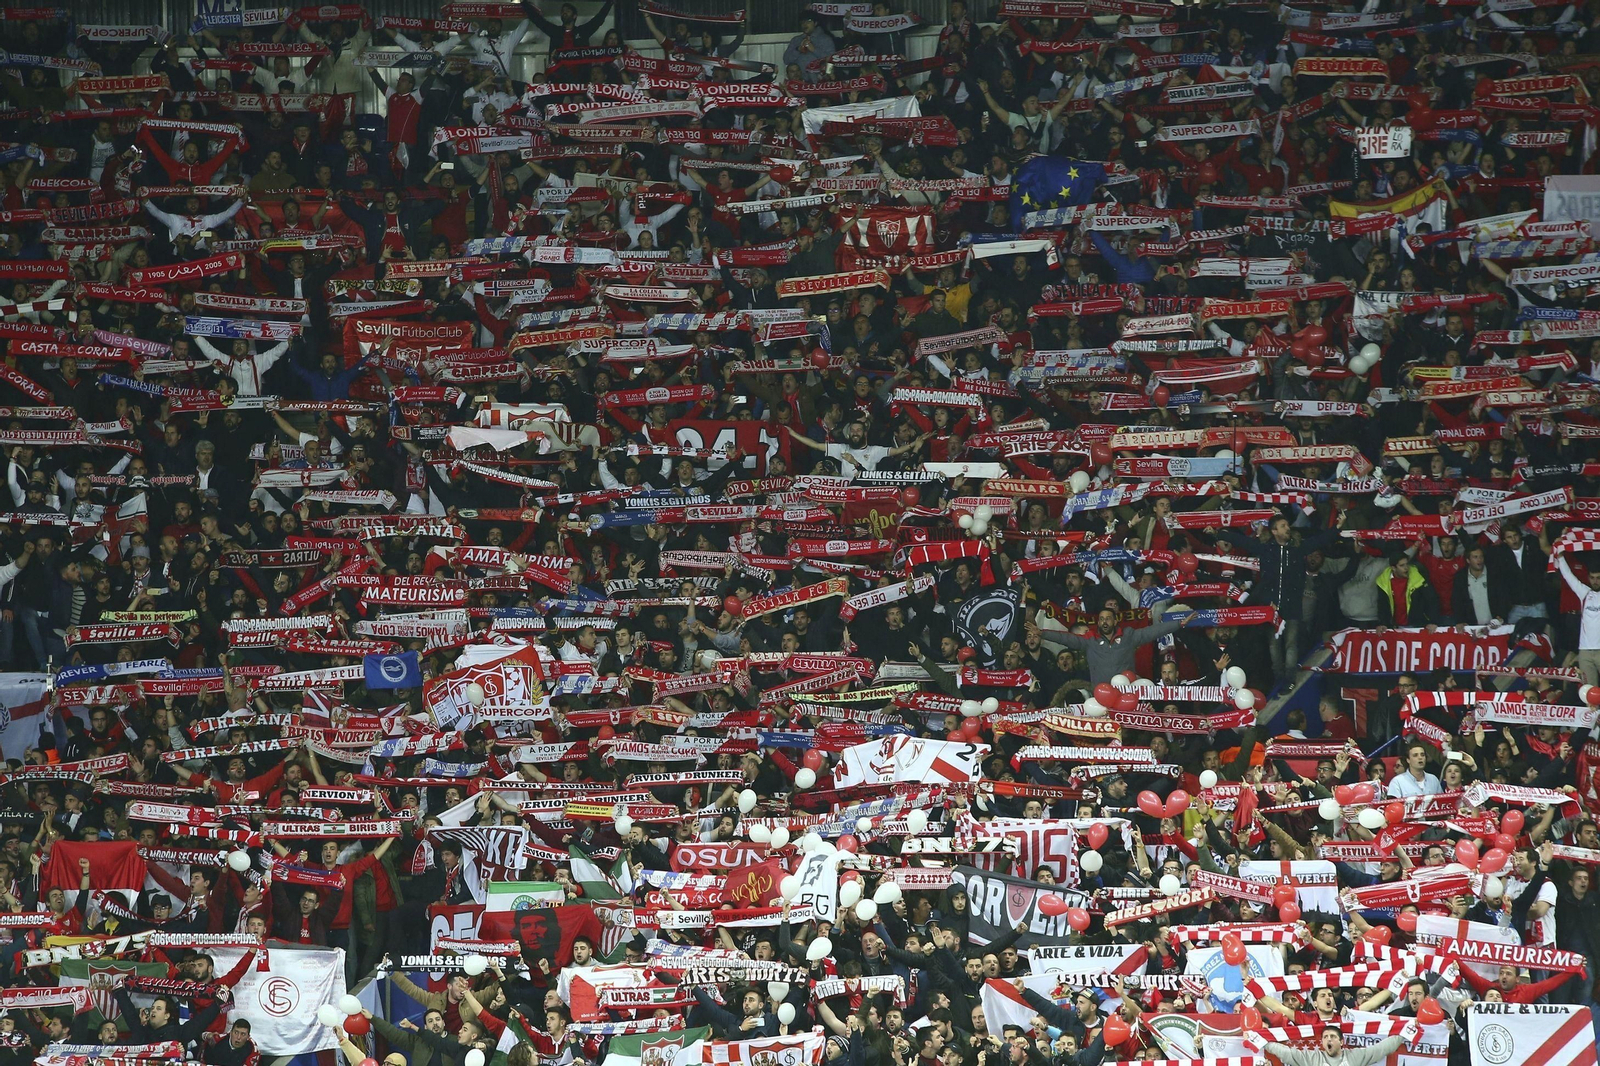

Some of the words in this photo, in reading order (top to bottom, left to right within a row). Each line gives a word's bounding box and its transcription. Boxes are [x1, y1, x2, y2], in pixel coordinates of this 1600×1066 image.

[208, 14, 241, 25] LEICESTER
[244, 11, 277, 21] SEVILLA
[385, 17, 402, 26] FINAL
[405, 19, 422, 27] COPA
[434, 21, 450, 30] DEL
[451, 23, 469, 31] REY
[851, 18, 908, 28] SUPERCOPA
[83, 26, 150, 37] SUPERCOPA
[10, 53, 39, 62] LEICESTER
[413, 53, 434, 61] SPURS
[832, 54, 877, 62] Sevilla
[1142, 56, 1175, 66] SEVILLA
[1312, 62, 1363, 70] SEVILLA
[83, 79, 135, 90] SEVILLA
[701, 84, 768, 95] LONDRES
[802, 81, 842, 90] SEVILLA
[568, 129, 613, 137] SEVILLA
[618, 129, 631, 137] FC
[1172, 125, 1237, 135] SUPERCOPA
[1516, 133, 1551, 144] SEVILLA
[817, 178, 837, 189] COPA
[195, 186, 235, 194] SEVILLA
[1096, 217, 1165, 226] SUPERCOPA
[65, 227, 131, 238] CAMPEON
[910, 254, 961, 264] SEVILLA
[205, 261, 222, 269] 2005
[403, 264, 451, 272] SEVILLA
[665, 268, 709, 276] SEVILLA
[801, 280, 850, 291] SEVILLA
[210, 294, 256, 305] SEVILLA
[1537, 309, 1577, 319] LEICESTER
[356, 321, 463, 338] SevillaFútbolClub
[1547, 322, 1579, 331] VAMOS
[584, 338, 654, 348] SUPERCOPA
[21, 343, 58, 353] CASTA
[78, 345, 122, 357] CORAJE
[452, 364, 517, 377] CAMPEON
[8, 372, 46, 400] CORAJE
[126, 378, 160, 392] LEICESTER
[168, 387, 202, 396] SEVILLA
[1439, 380, 1492, 392] SEVILLA
[32, 409, 72, 417] SEVILLA
[1441, 429, 1462, 438] FINAL
[1466, 428, 1485, 437] COPA
[1136, 460, 1163, 468] Sevilla
[988, 482, 1032, 491] SEVILLA
[1036, 484, 1059, 493] F.C.
[1286, 477, 1318, 489] ULTRAS
[1342, 480, 1370, 490] BIRIS
[727, 483, 748, 496] ORO
[625, 494, 711, 507] YONKIS&GITANOS
[701, 507, 743, 516] SEVILLA
[1056, 553, 1095, 562] CHAMPIONS
[361, 577, 380, 585] COPA
[394, 577, 412, 585] DEL
[745, 592, 799, 612] SEVILLA
[809, 584, 824, 595] F.C.
[90, 628, 135, 638] Sevilla
[372, 624, 396, 634] COPA
[236, 633, 278, 642] Sevilla
[1345, 641, 1388, 672] LOS
[1399, 641, 1420, 671] DE
[793, 658, 838, 670] SEVILLA
[258, 679, 305, 687] Sevilla
[666, 677, 713, 689] SEVILLA
[64, 690, 117, 701] SEVILLA
[813, 693, 841, 701] Sevilla
[861, 688, 897, 698] pertenece
[478, 708, 550, 717] SUPERCOPA
[1491, 703, 1527, 715] VAMOS
[1550, 706, 1576, 718] COPA
[1046, 715, 1093, 731] SEVILLA
[1096, 722, 1115, 732] F.C.
[1115, 713, 1161, 728] SEVILLA
[1173, 717, 1194, 729] F.C.
[288, 727, 322, 739] BIRIS
[336, 730, 376, 742] NORTE
[615, 744, 648, 753] VAMOS
[685, 769, 744, 779] DRUNKERS
[1481, 783, 1516, 794] VAMOS
[303, 789, 355, 800] NERVION
[282, 824, 320, 832] ULTRAS
[350, 824, 377, 832] BIRIS
[1197, 872, 1241, 891] SEVILLA
[1246, 884, 1259, 895] FC
[1282, 874, 1290, 885] A
[1300, 873, 1335, 884] VERTE
[1106, 903, 1152, 924] BIRIS
[1034, 947, 1069, 958] ARTE
[1076, 947, 1086, 958] &
[1091, 946, 1123, 958] VIDA
[611, 992, 650, 1002] ULTRAS
[1474, 1005, 1510, 1014] ARTE
[1519, 1005, 1534, 1014] &
[1534, 1005, 1570, 1014] VIDA
[1405, 1043, 1447, 1056] VERTE
